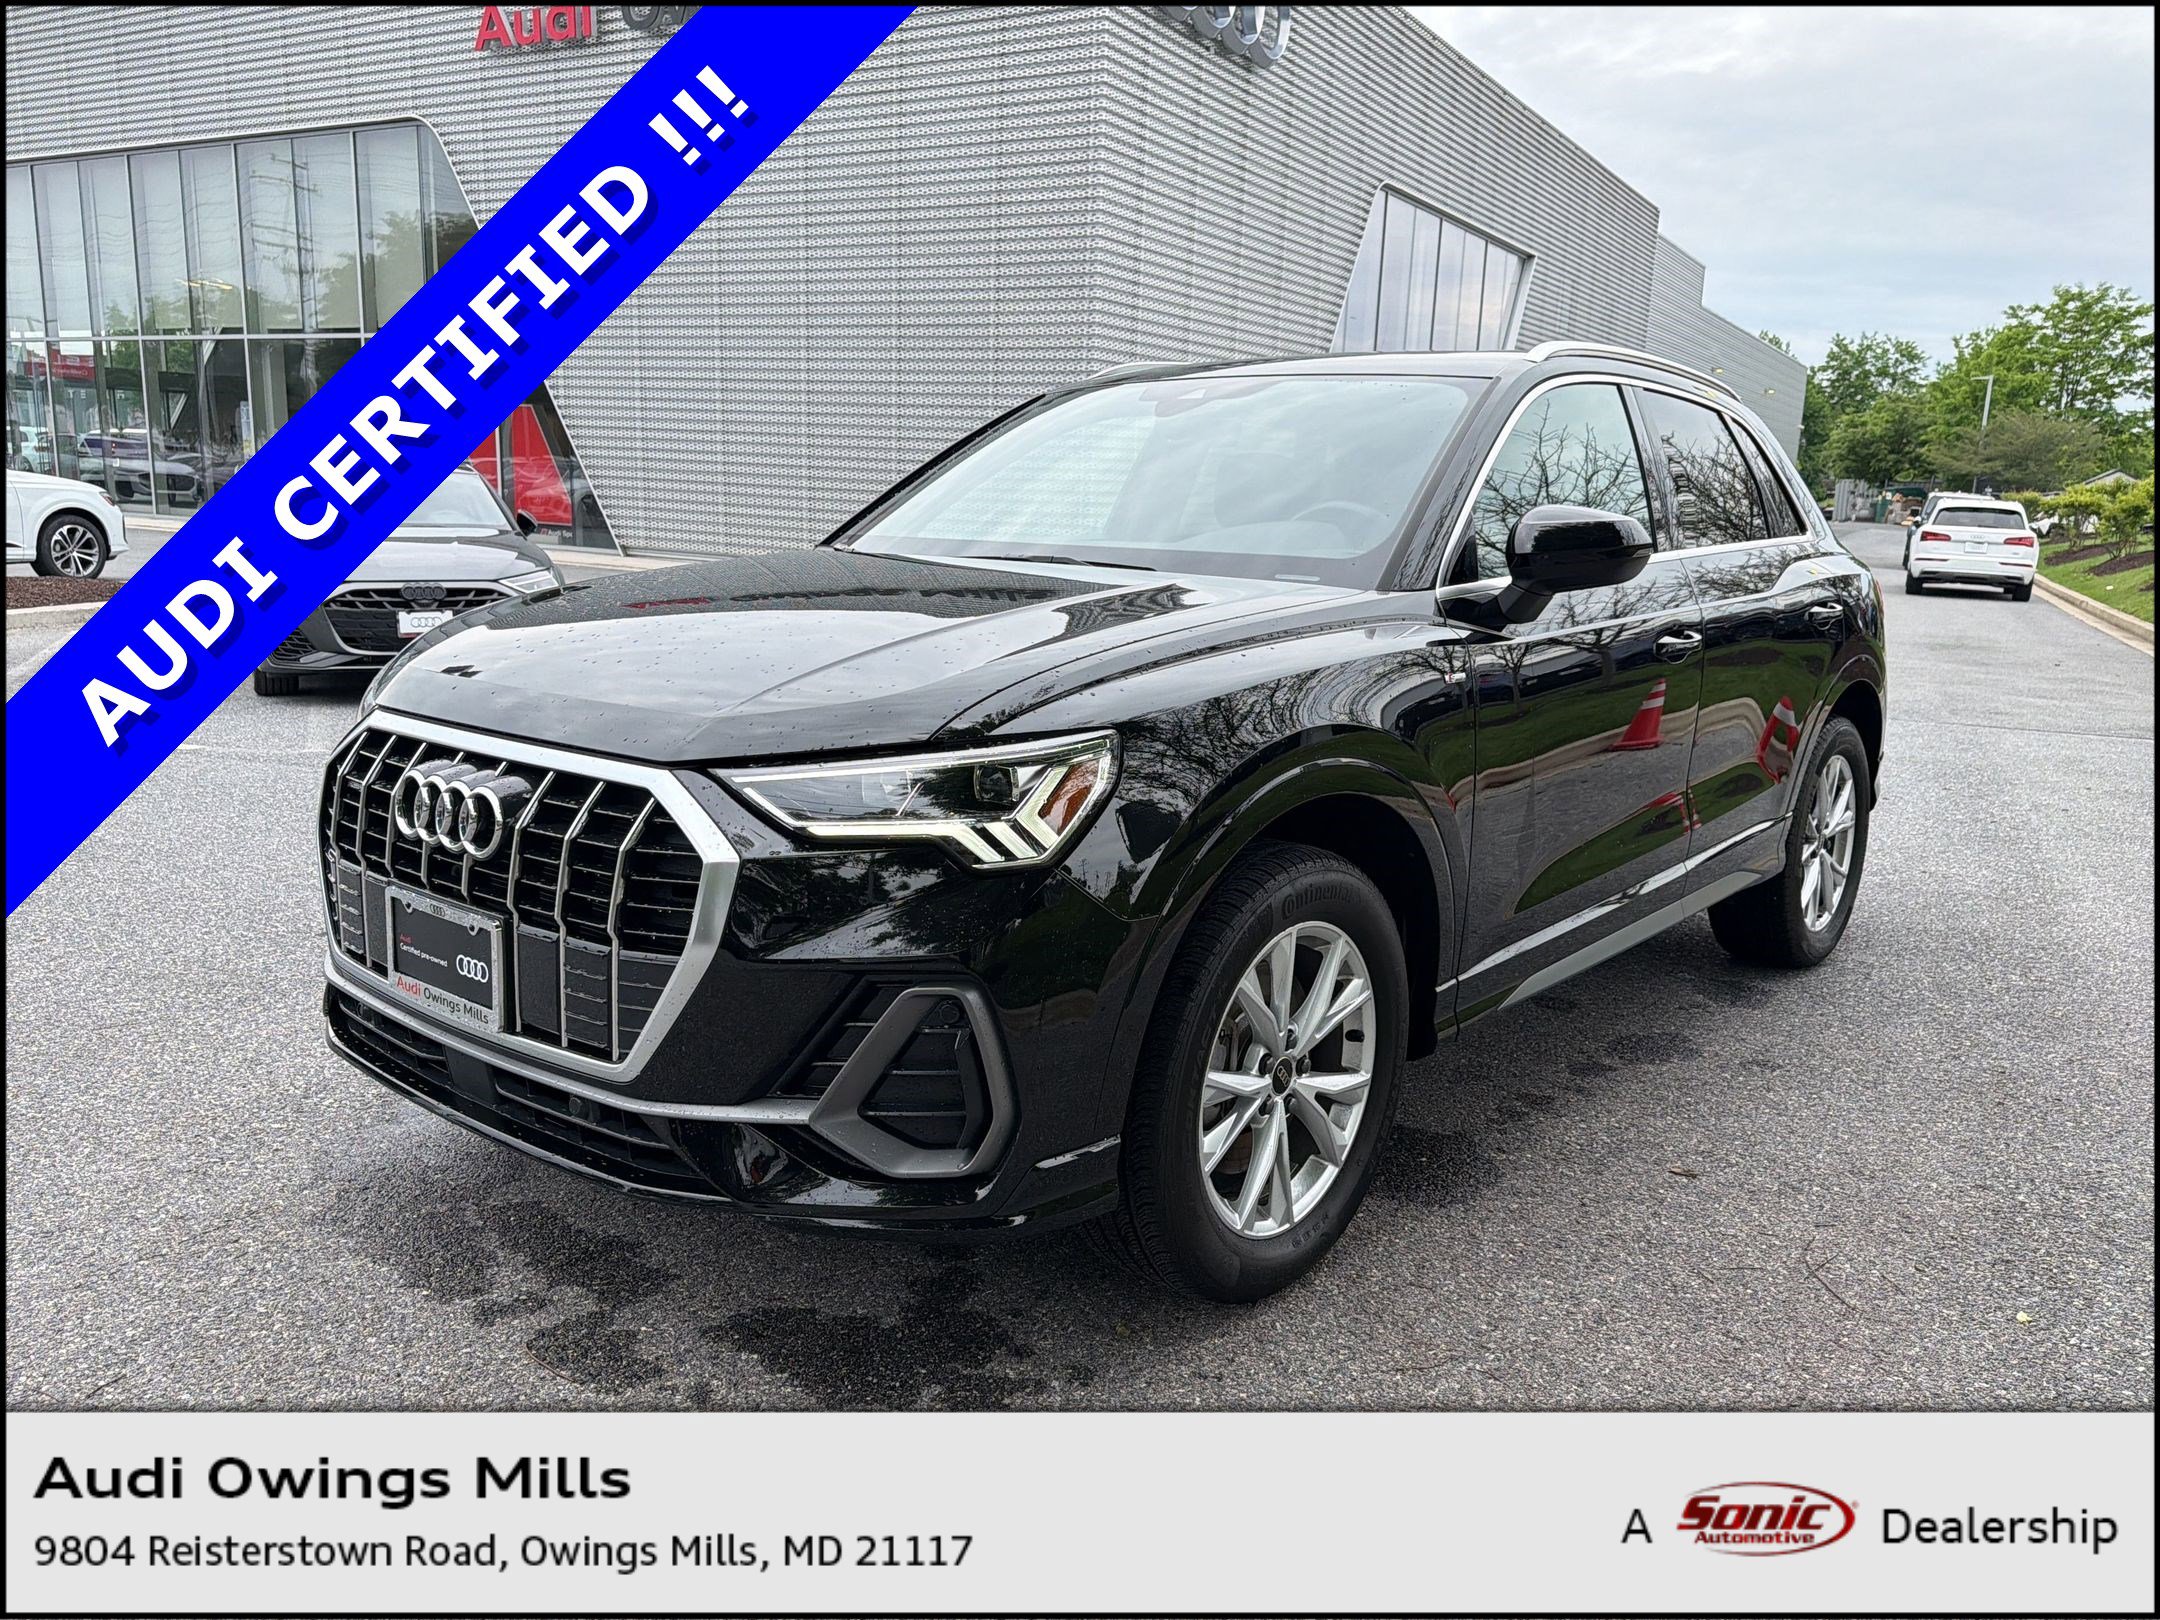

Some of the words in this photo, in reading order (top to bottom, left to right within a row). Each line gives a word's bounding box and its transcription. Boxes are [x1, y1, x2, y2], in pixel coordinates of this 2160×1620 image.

[400, 934, 412, 944] Audi
[400, 942, 421, 957] Certified
[421, 952, 448, 968] pre-owned
[396, 976, 421, 996] Audi
[423, 987, 461, 1013] Owings
[463, 1003, 489, 1024] Mills
